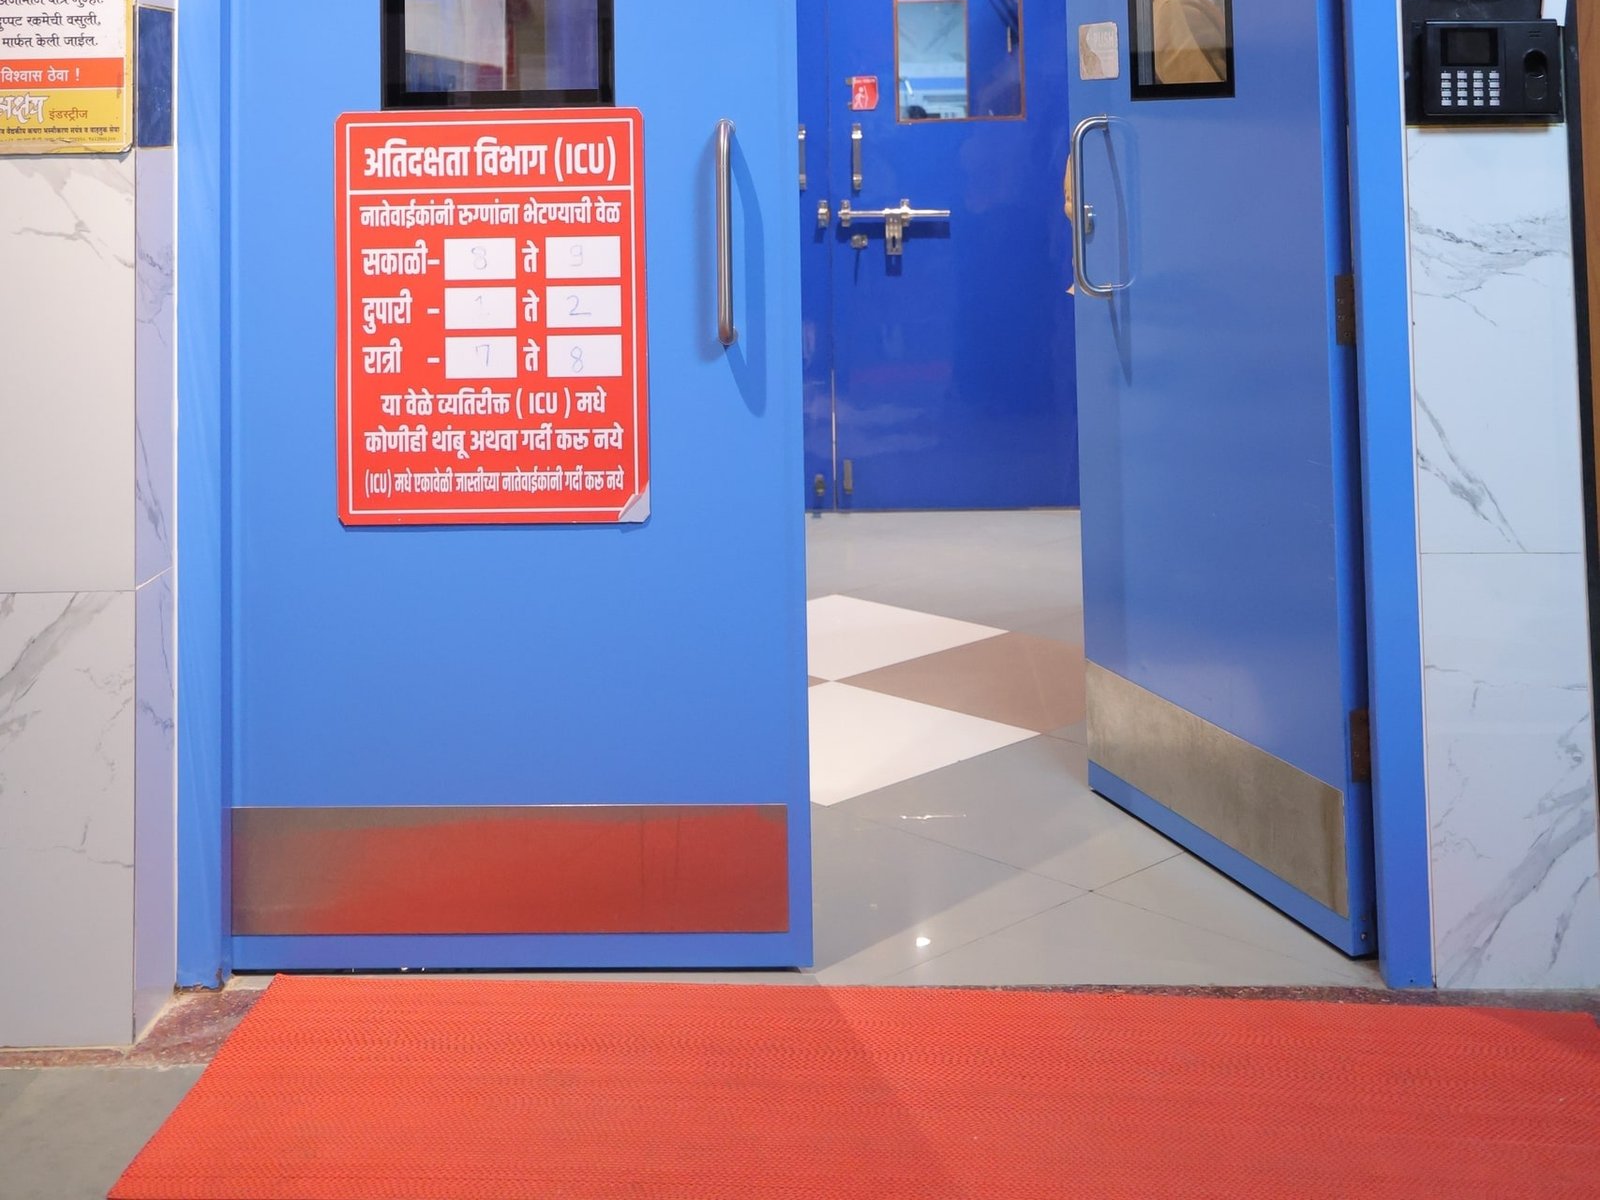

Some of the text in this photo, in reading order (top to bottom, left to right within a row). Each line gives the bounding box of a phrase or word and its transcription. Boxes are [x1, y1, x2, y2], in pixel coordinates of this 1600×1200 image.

[26, 12, 62, 26] रकमेची
[2, 33, 33, 47] मार्फत
[35, 33, 60, 47] केली
[1, 66, 43, 83] विश्वास
[47, 65, 69, 82] ठेवा
[48, 107, 88, 121] इंडस्ट्रीज
[363, 135, 617, 182] अतिदक्षता विभाग (ICU)
[359, 195, 622, 229] नातेवाईकांनी रुग्णांना भेटण्याची वेळ
[521, 240, 540, 273] ते
[361, 288, 413, 334] दुपारी
[522, 289, 540, 322] ते
[566, 295, 592, 316] 2
[362, 337, 403, 374] रात्री
[475, 344, 491, 368] 7
[523, 338, 541, 371] ते
[570, 346, 584, 373] 8
[380, 395, 402, 416] या
[404, 387, 434, 416] वेळे
[575, 385, 607, 414] मधे
[364, 424, 428, 453] कोणीही
[432, 424, 470, 460] थांबू
[470, 429, 518, 452] अथवा
[521, 422, 553, 451] गर्दी
[592, 421, 624, 450] नये
[365, 468, 392, 498] (ICU)
[413, 466, 453, 493] एकावेळी
[501, 465, 563, 494] नातेवाईकांनी
[564, 464, 583, 492] गर्दी
[605, 464, 625, 492] नये
